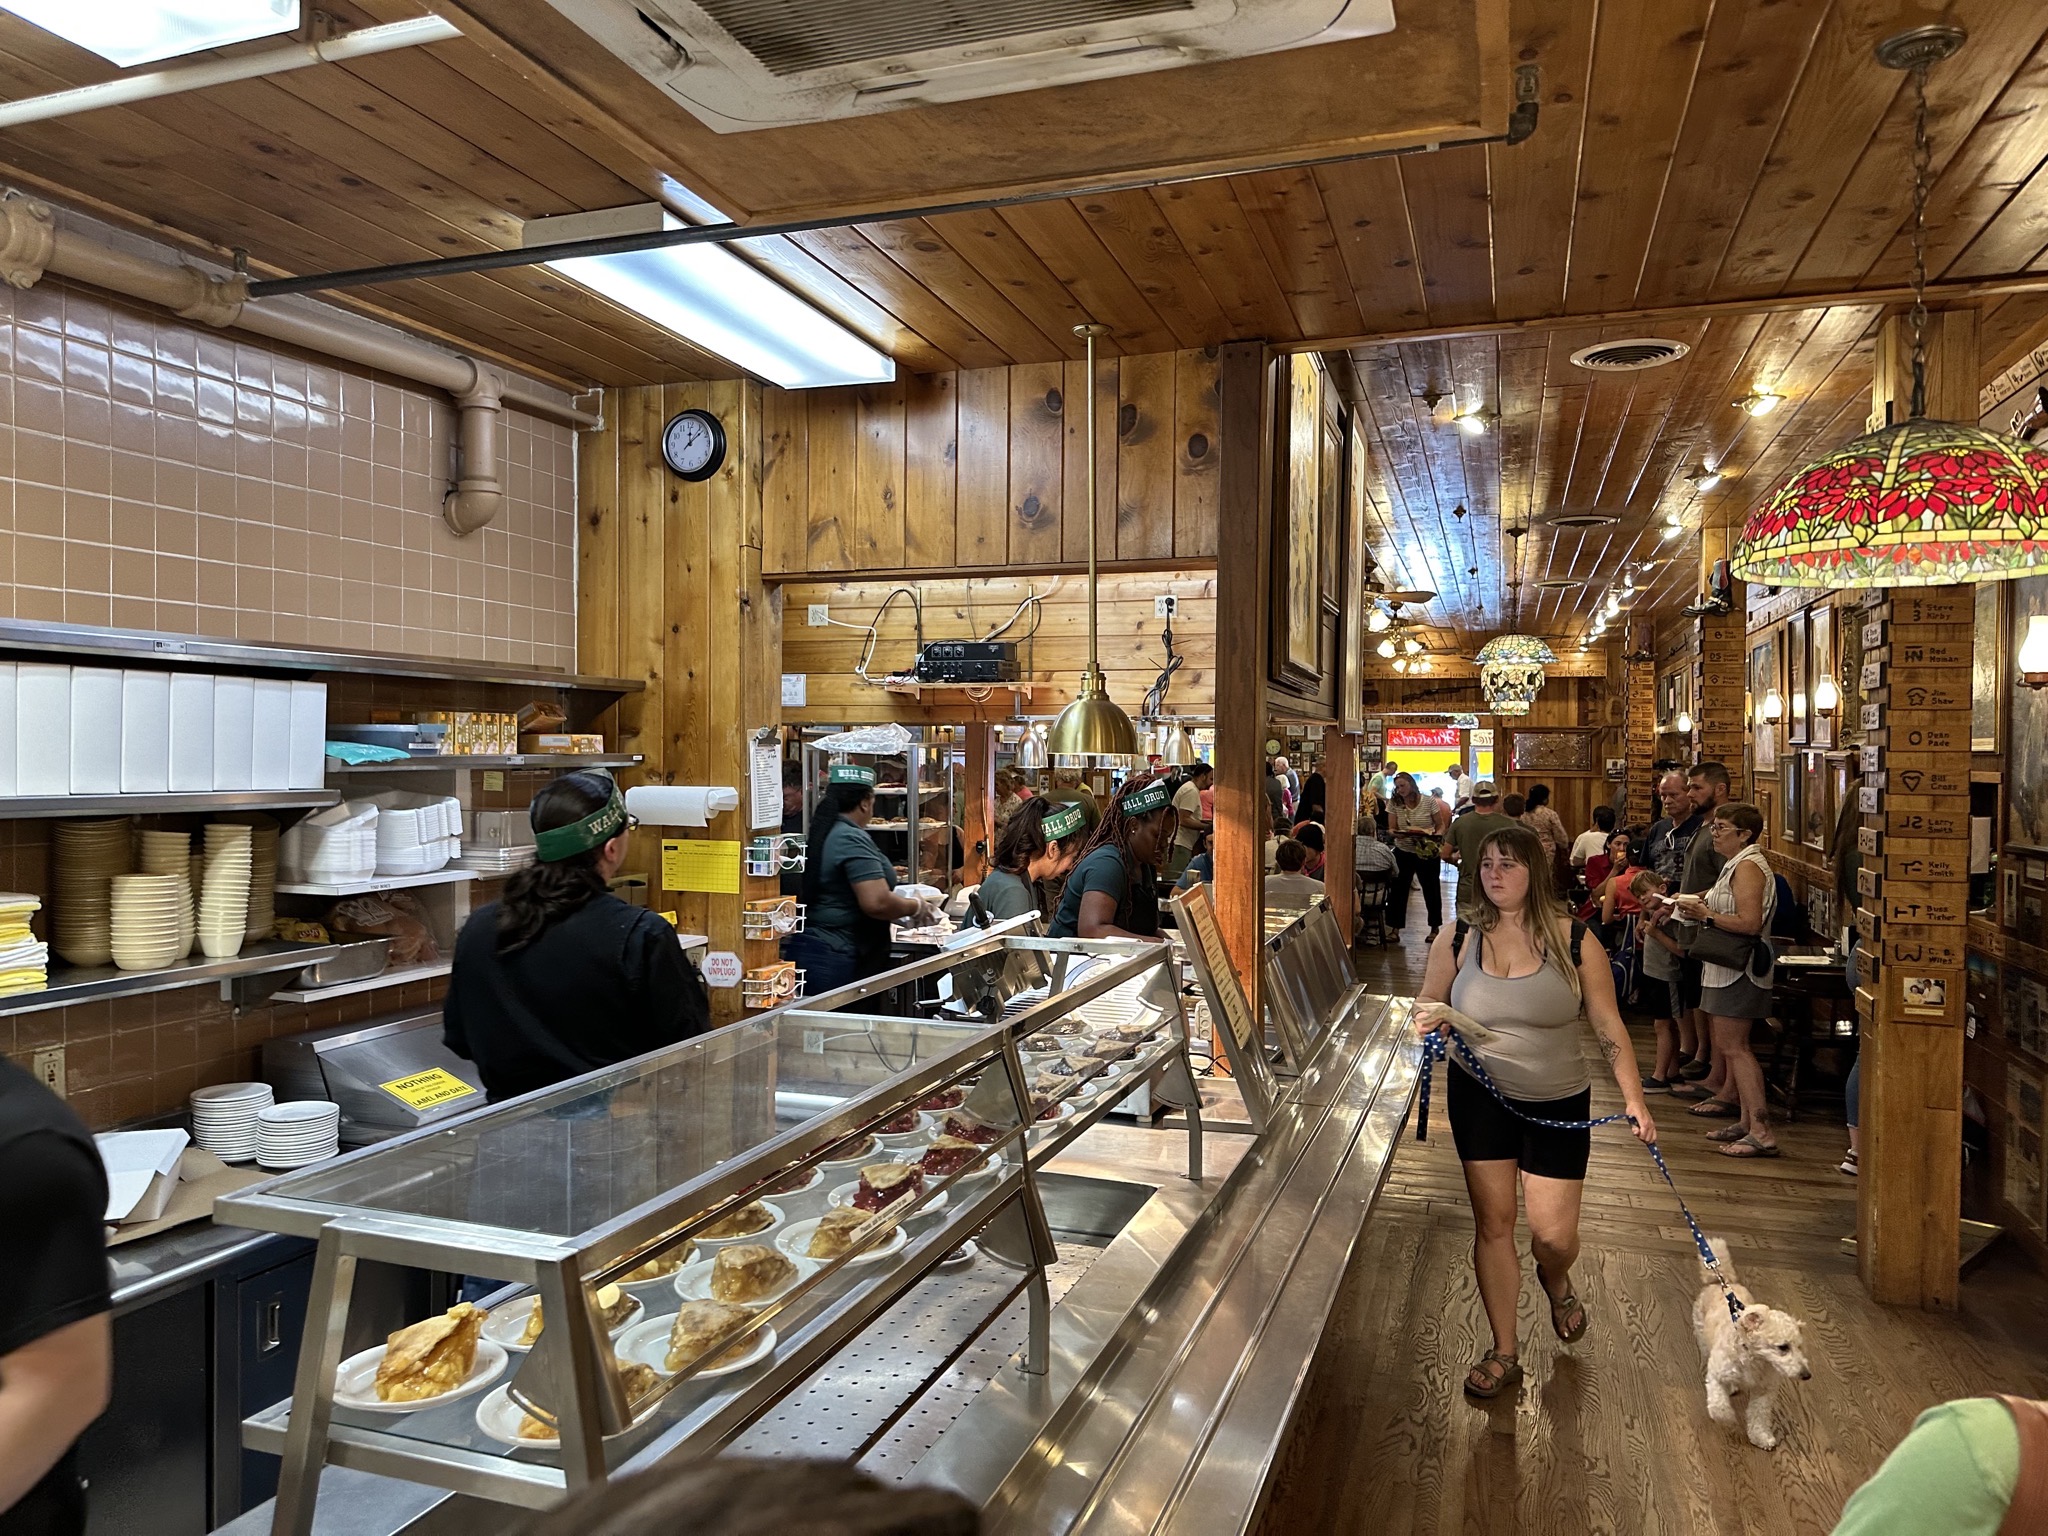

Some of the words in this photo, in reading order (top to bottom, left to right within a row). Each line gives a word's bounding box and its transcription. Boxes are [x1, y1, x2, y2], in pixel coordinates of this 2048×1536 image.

[1926, 612, 1951, 620] Kirby
[1931, 783, 1958, 791] Cross
[1122, 797, 1142, 810] WALL
[1144, 790, 1165, 804] DRUG
[1064, 808, 1082, 824] DRUG
[1928, 818, 1954, 826] Larry
[1928, 861, 1950, 870] Kelly
[1926, 913, 1957, 921] Tisher
[711, 958, 720, 966] DO
[721, 958, 733, 966] NOT
[396, 1074, 442, 1090] NOTHING
[412, 1094, 435, 1106] LABEL
[435, 1091, 450, 1100] AND
[452, 1086, 468, 1094] DATE
